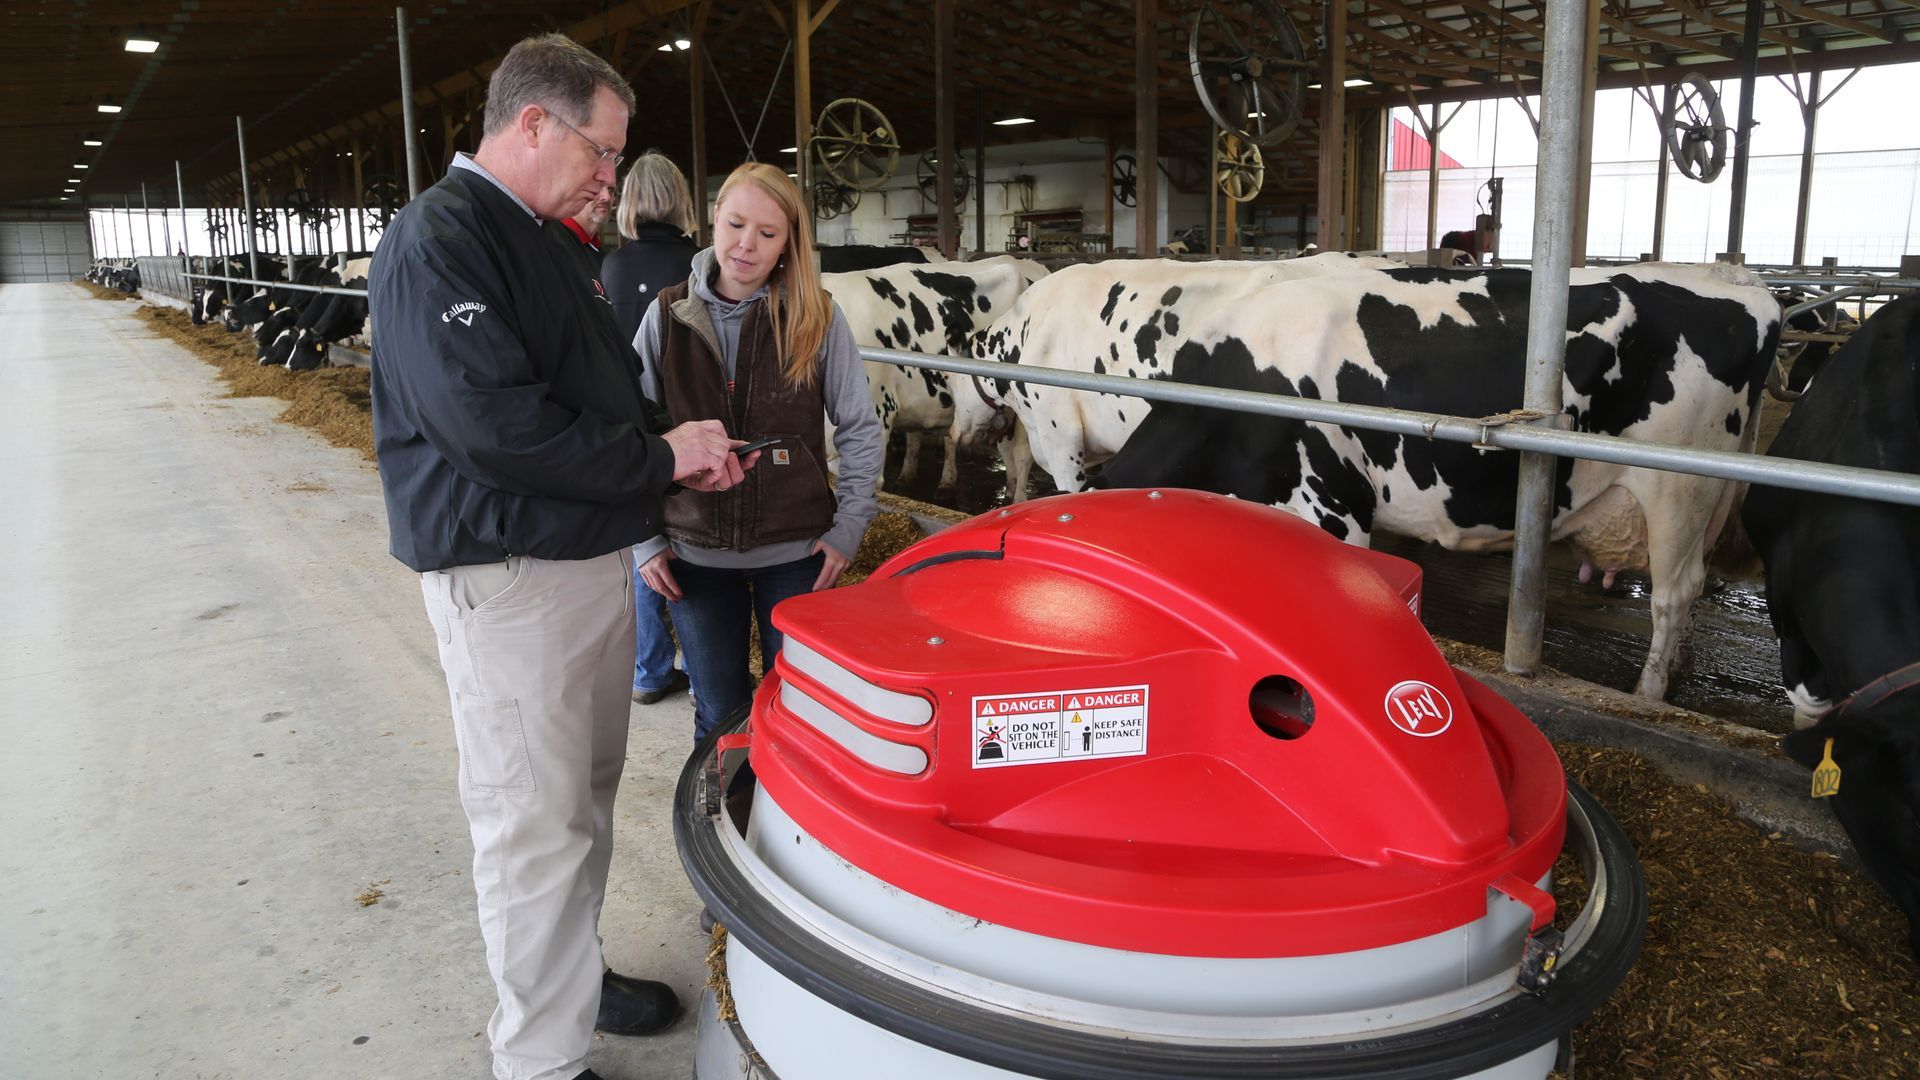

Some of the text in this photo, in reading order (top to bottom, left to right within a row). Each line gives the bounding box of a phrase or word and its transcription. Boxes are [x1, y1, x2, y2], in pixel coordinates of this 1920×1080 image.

[441, 301, 487, 323] Callaway
[999, 699, 1056, 713] DANGER
[1084, 693, 1140, 707] DANGER
[1392, 687, 1444, 730] LELY
[1012, 721, 1055, 733] DO NOT
[1094, 718, 1143, 730] KEEP SAFE
[1009, 730, 1058, 742] SIT ON THE
[1095, 728, 1141, 740] DISTANCE
[1011, 740, 1056, 750] VEHICLE
[1815, 768, 1839, 796] 802
